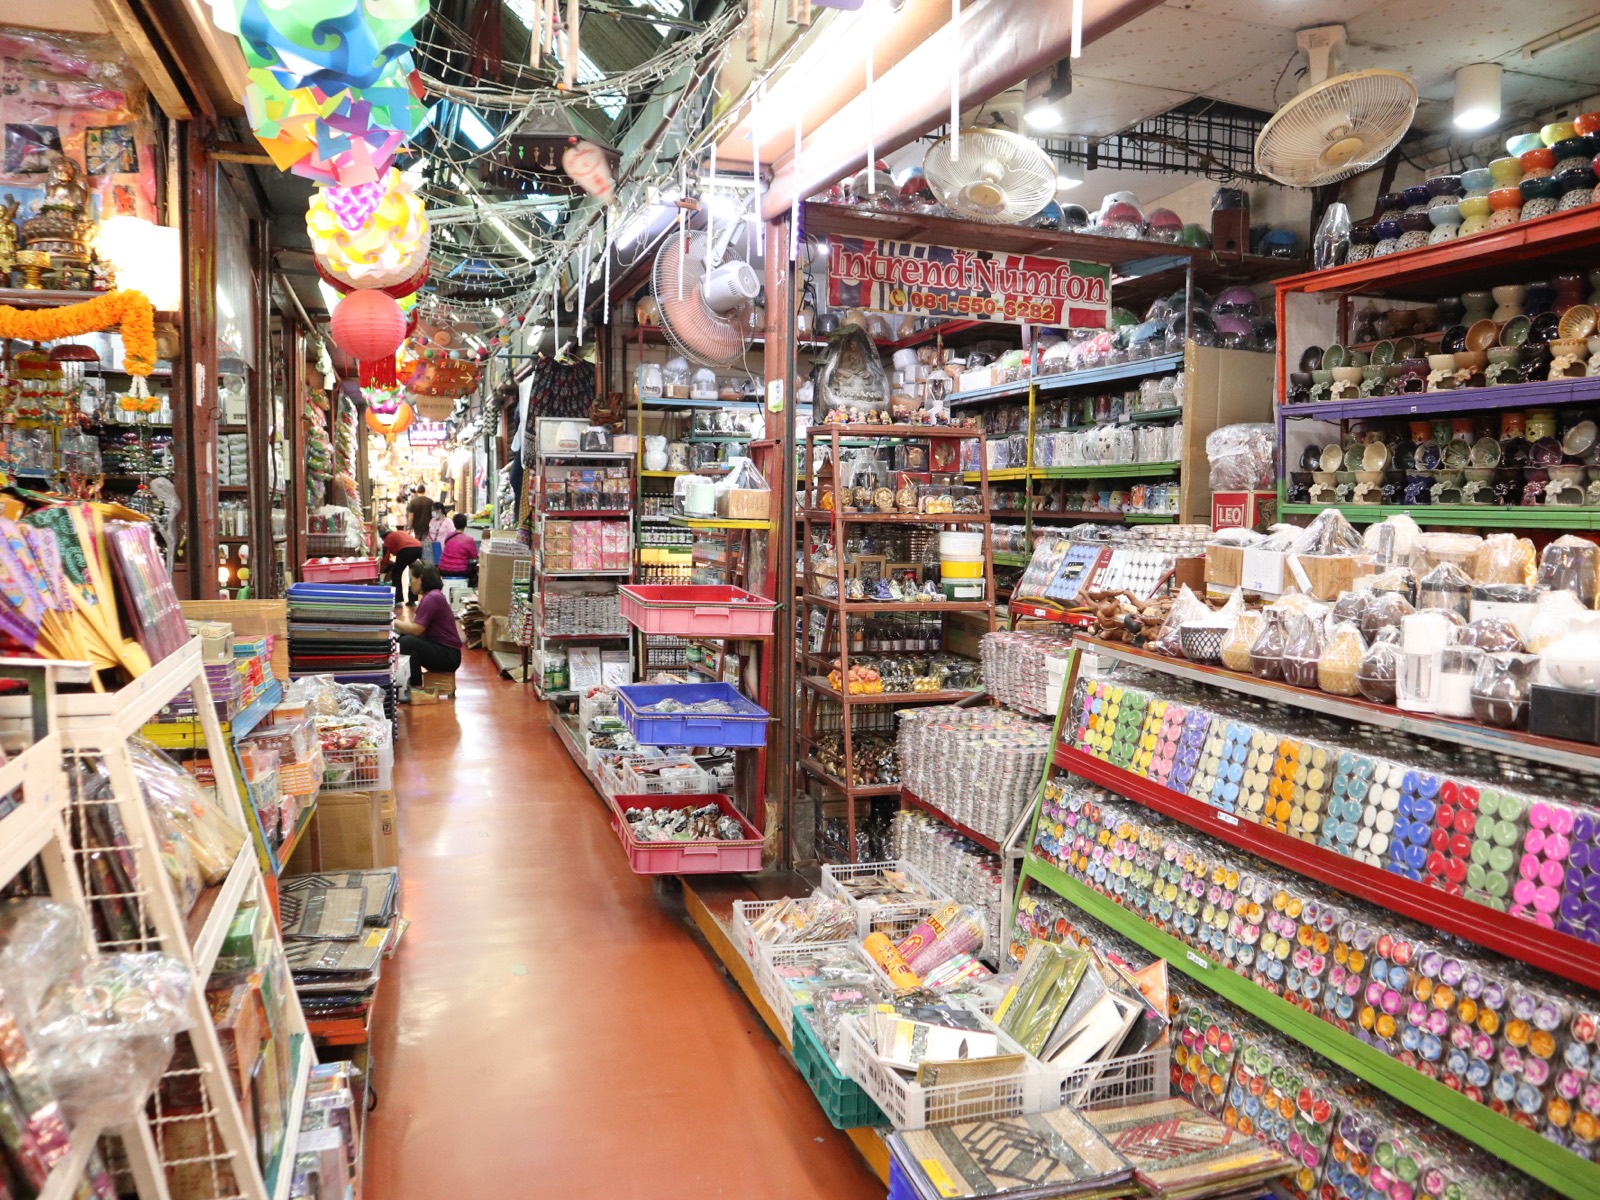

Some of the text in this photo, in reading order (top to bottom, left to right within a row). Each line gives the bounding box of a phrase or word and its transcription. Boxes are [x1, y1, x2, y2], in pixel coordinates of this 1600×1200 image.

[830, 243, 1109, 305] Intrend Numfon
[910, 292, 1055, 320] 081-550-6282
[1219, 507, 1242, 524] LEO
